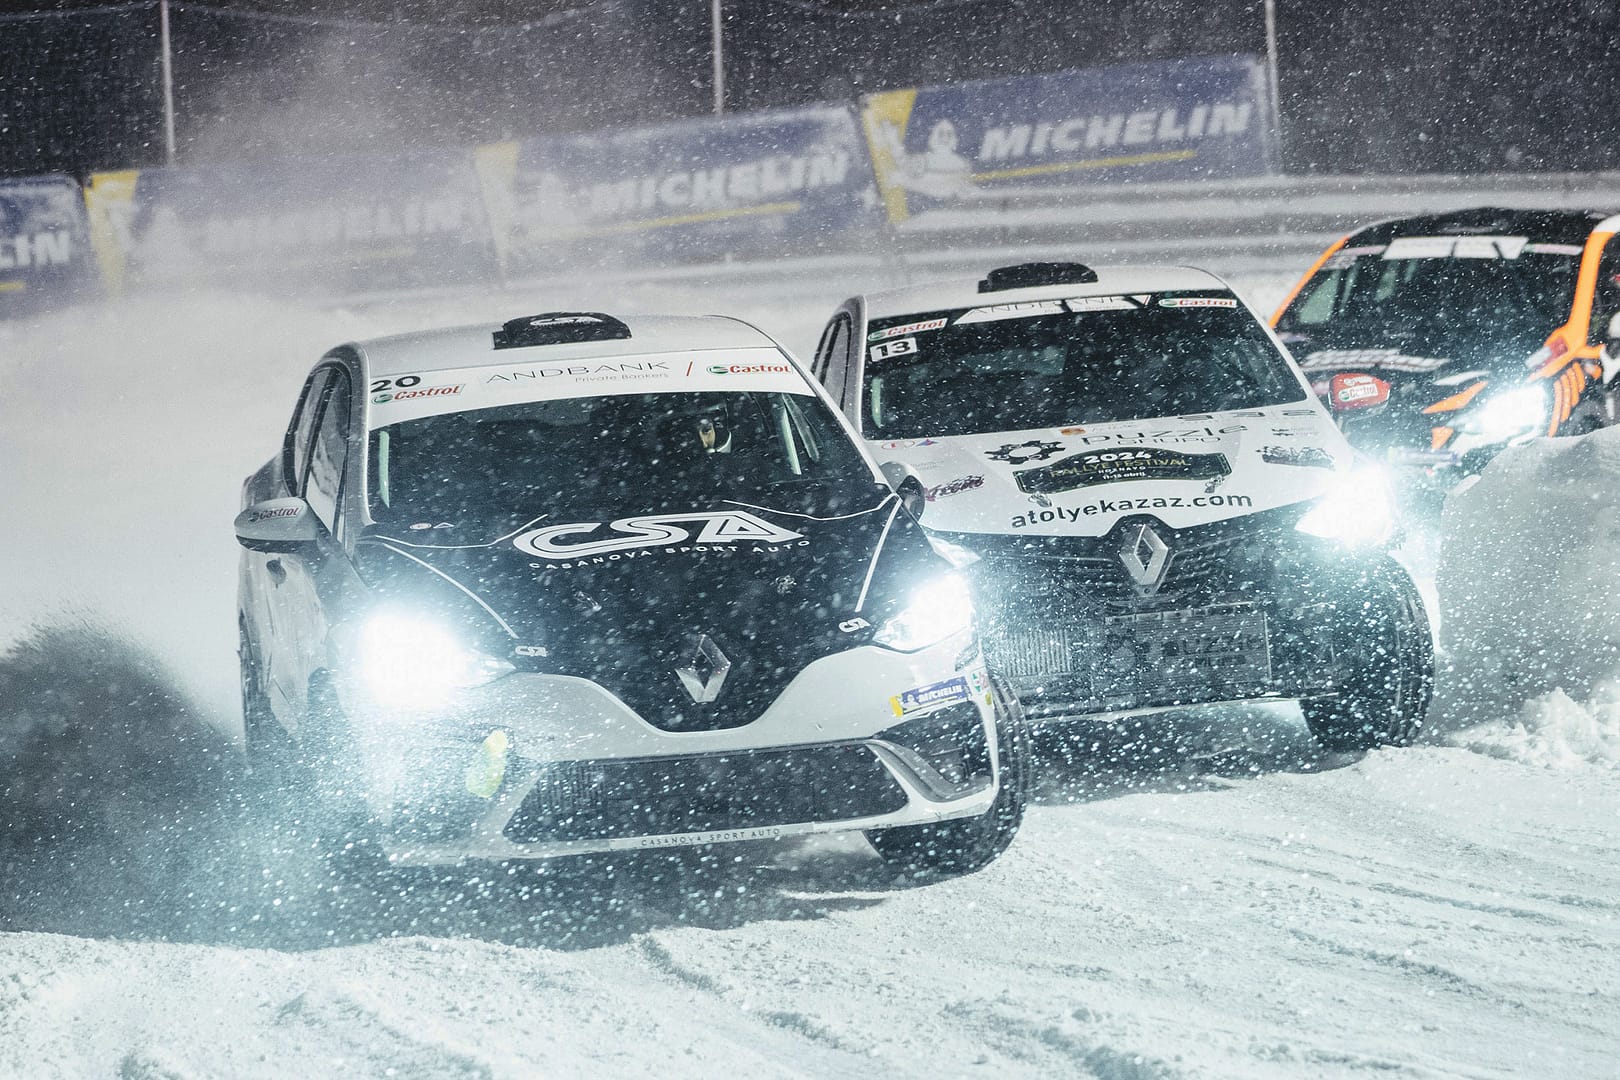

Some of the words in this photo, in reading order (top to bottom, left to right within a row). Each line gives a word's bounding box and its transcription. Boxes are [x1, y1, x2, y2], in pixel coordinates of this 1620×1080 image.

[977, 102, 1251, 162] MICHELIN
[591, 149, 849, 213] MICHELIN
[887, 320, 944, 336] Castrol
[876, 341, 911, 358] 13
[487, 361, 669, 384] ANDBANK
[575, 374, 618, 384] Private
[621, 372, 670, 382] Bankers
[729, 364, 791, 374] Castrol
[370, 375, 422, 393] 20
[394, 385, 460, 401] Castrol
[1084, 451, 1152, 464] 2024
[1050, 462, 1110, 478] RALLYE
[1115, 458, 1192, 470] FESTIVAL
[260, 507, 299, 521] Castrol
[1011, 494, 1251, 528] atolyekazaz.com
[513, 510, 804, 559] CSA
[529, 549, 652, 569] CASANOVA
[665, 545, 738, 554] SPORT
[751, 540, 810, 554] AUTO
[641, 836, 701, 847] CASANOVA
[709, 831, 745, 842] SPORT
[752, 828, 781, 838] AUTO
